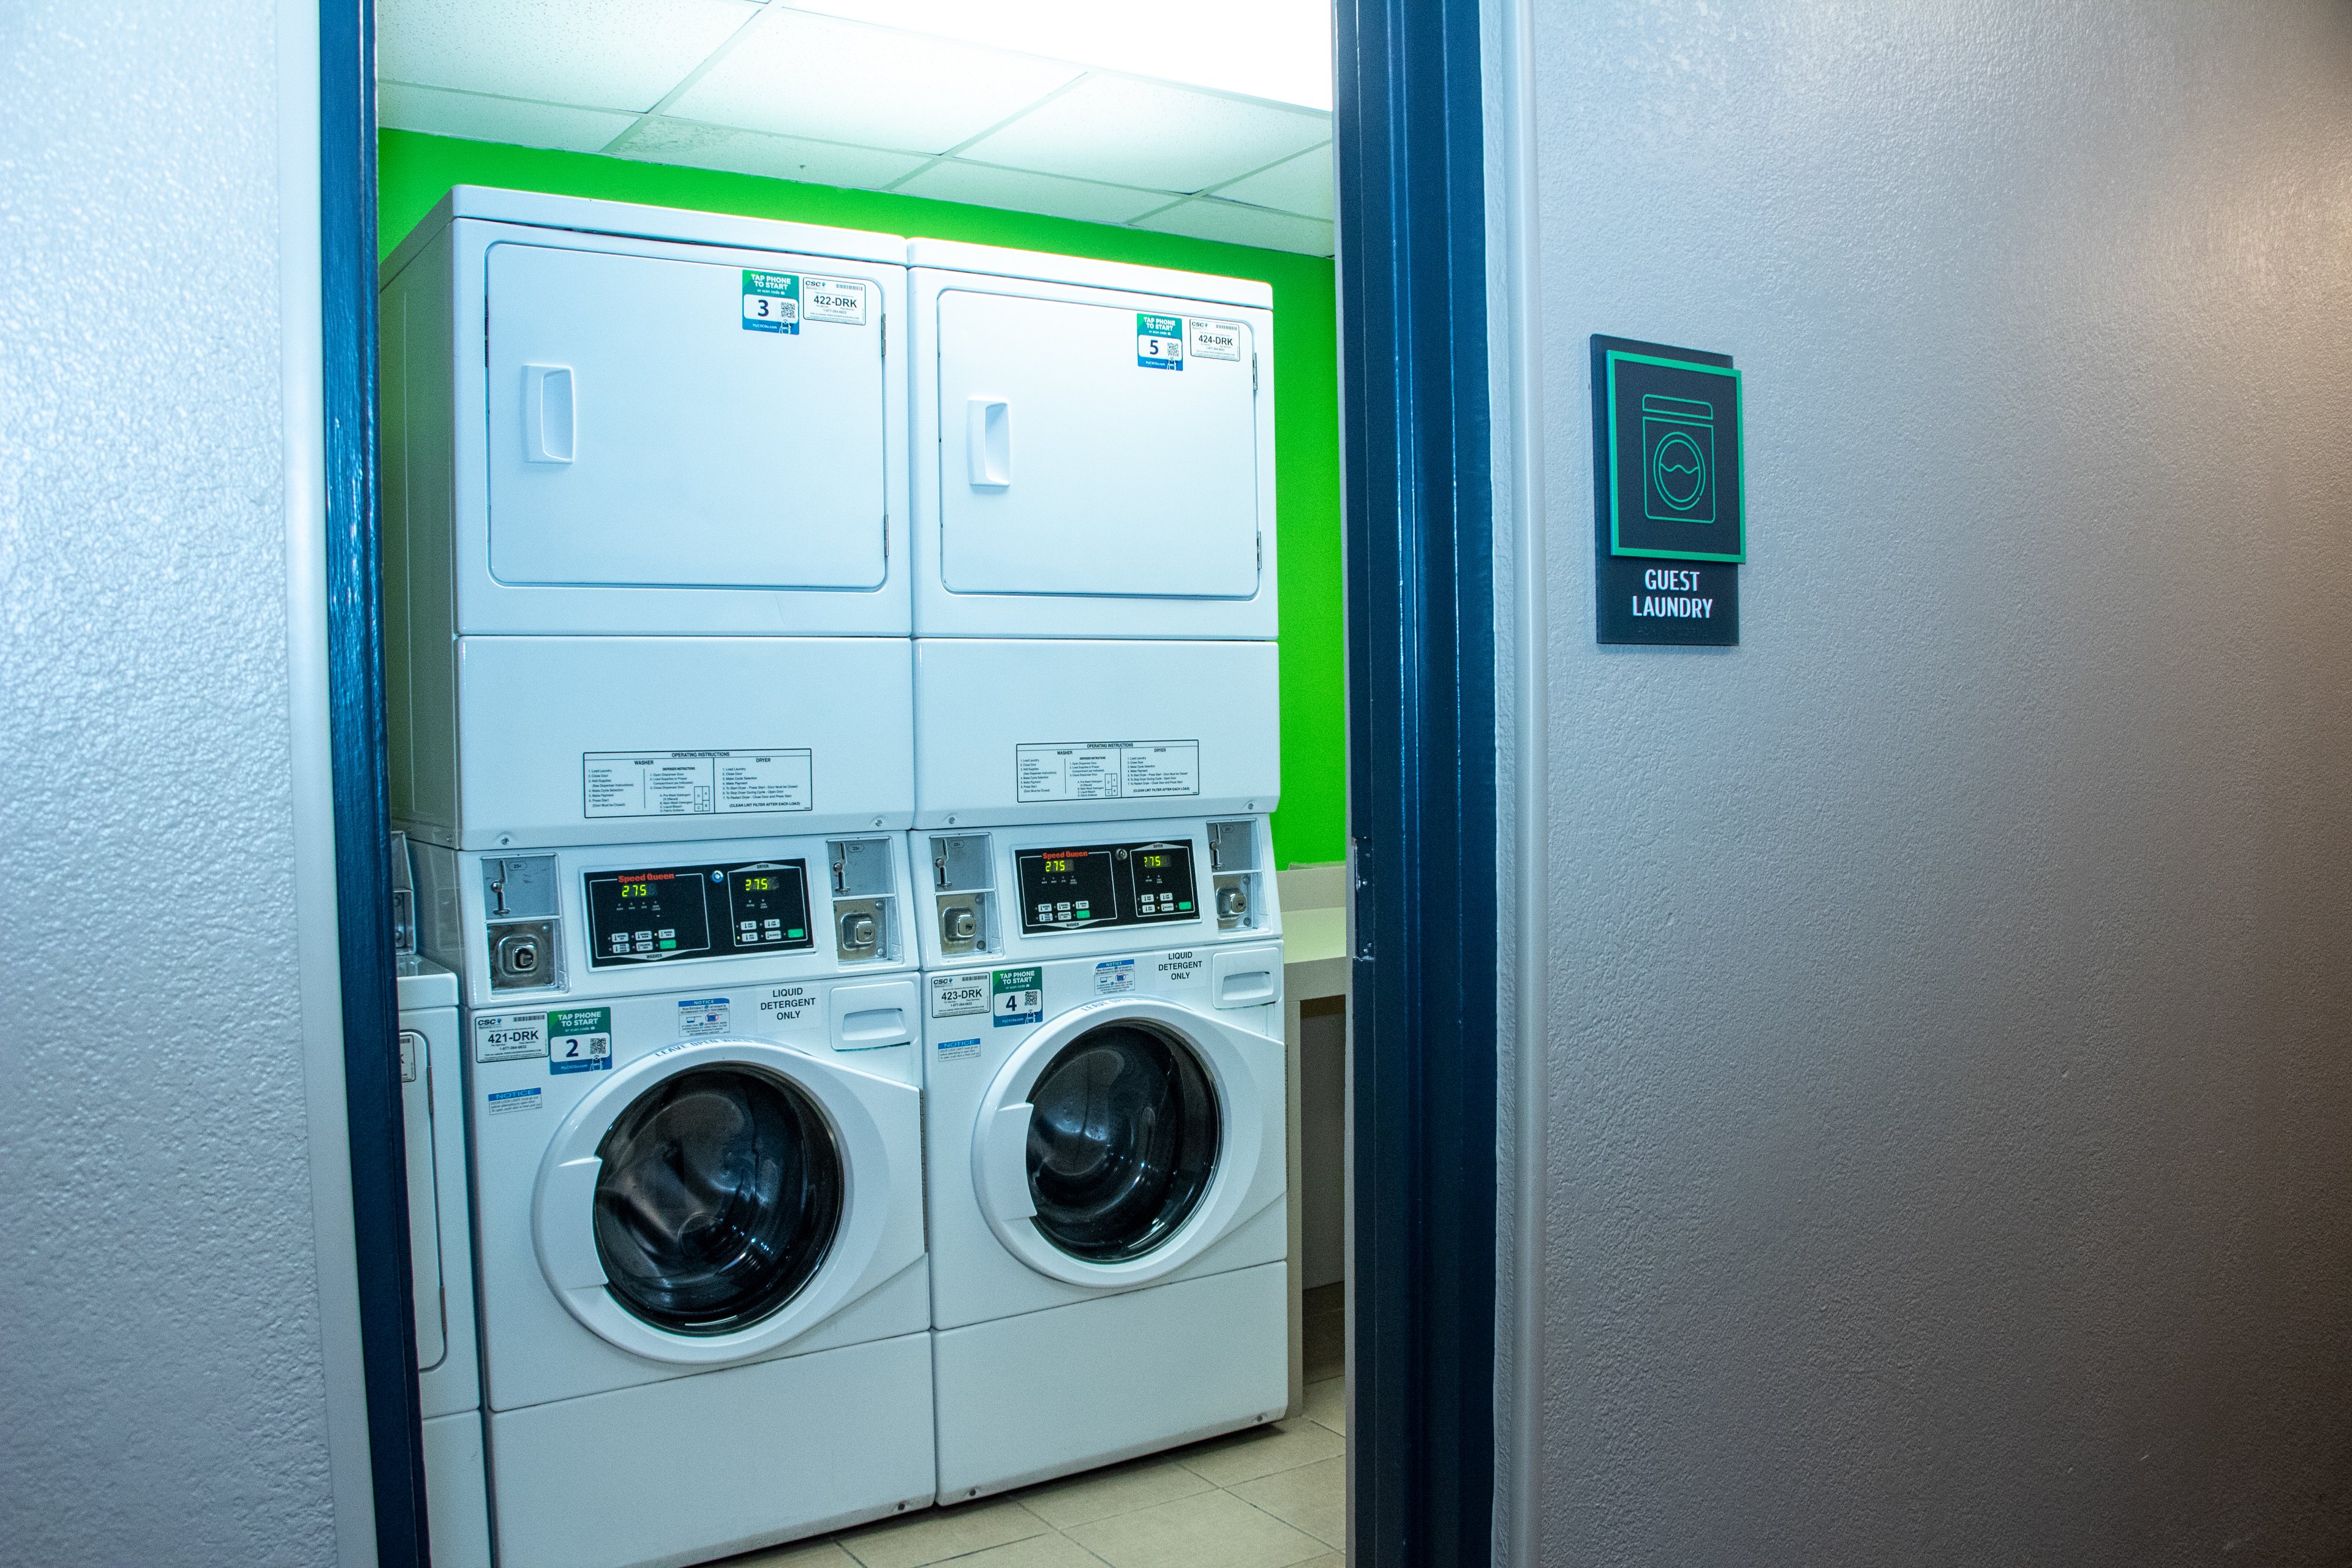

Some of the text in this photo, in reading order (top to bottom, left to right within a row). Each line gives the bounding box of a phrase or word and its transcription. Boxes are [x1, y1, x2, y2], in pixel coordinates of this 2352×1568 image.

[814, 295, 857, 308] 422-DRK
[758, 300, 769, 317] 3
[1199, 335, 1233, 346] 424-DRK
[1150, 340, 1158, 355] 5
[1645, 569, 1700, 592] GUEST
[1632, 595, 1713, 619] LAUNDRY
[1046, 861, 1065, 872] 275
[619, 874, 646, 883] Speed
[622, 884, 646, 897] 275
[1159, 961, 1202, 971] DETERGENT
[773, 987, 803, 997] LIQUID
[941, 989, 982, 1000] 423-DRK
[761, 998, 816, 1010] DETERGENT
[1006, 995, 1017, 1011] 4
[777, 1011, 801, 1020] ONLY
[488, 1030, 538, 1043] 421-DRK
[566, 1039, 578, 1057] 2
[654, 1045, 688, 1057] LEAVE
[497, 1090, 534, 1099] NOTICE
